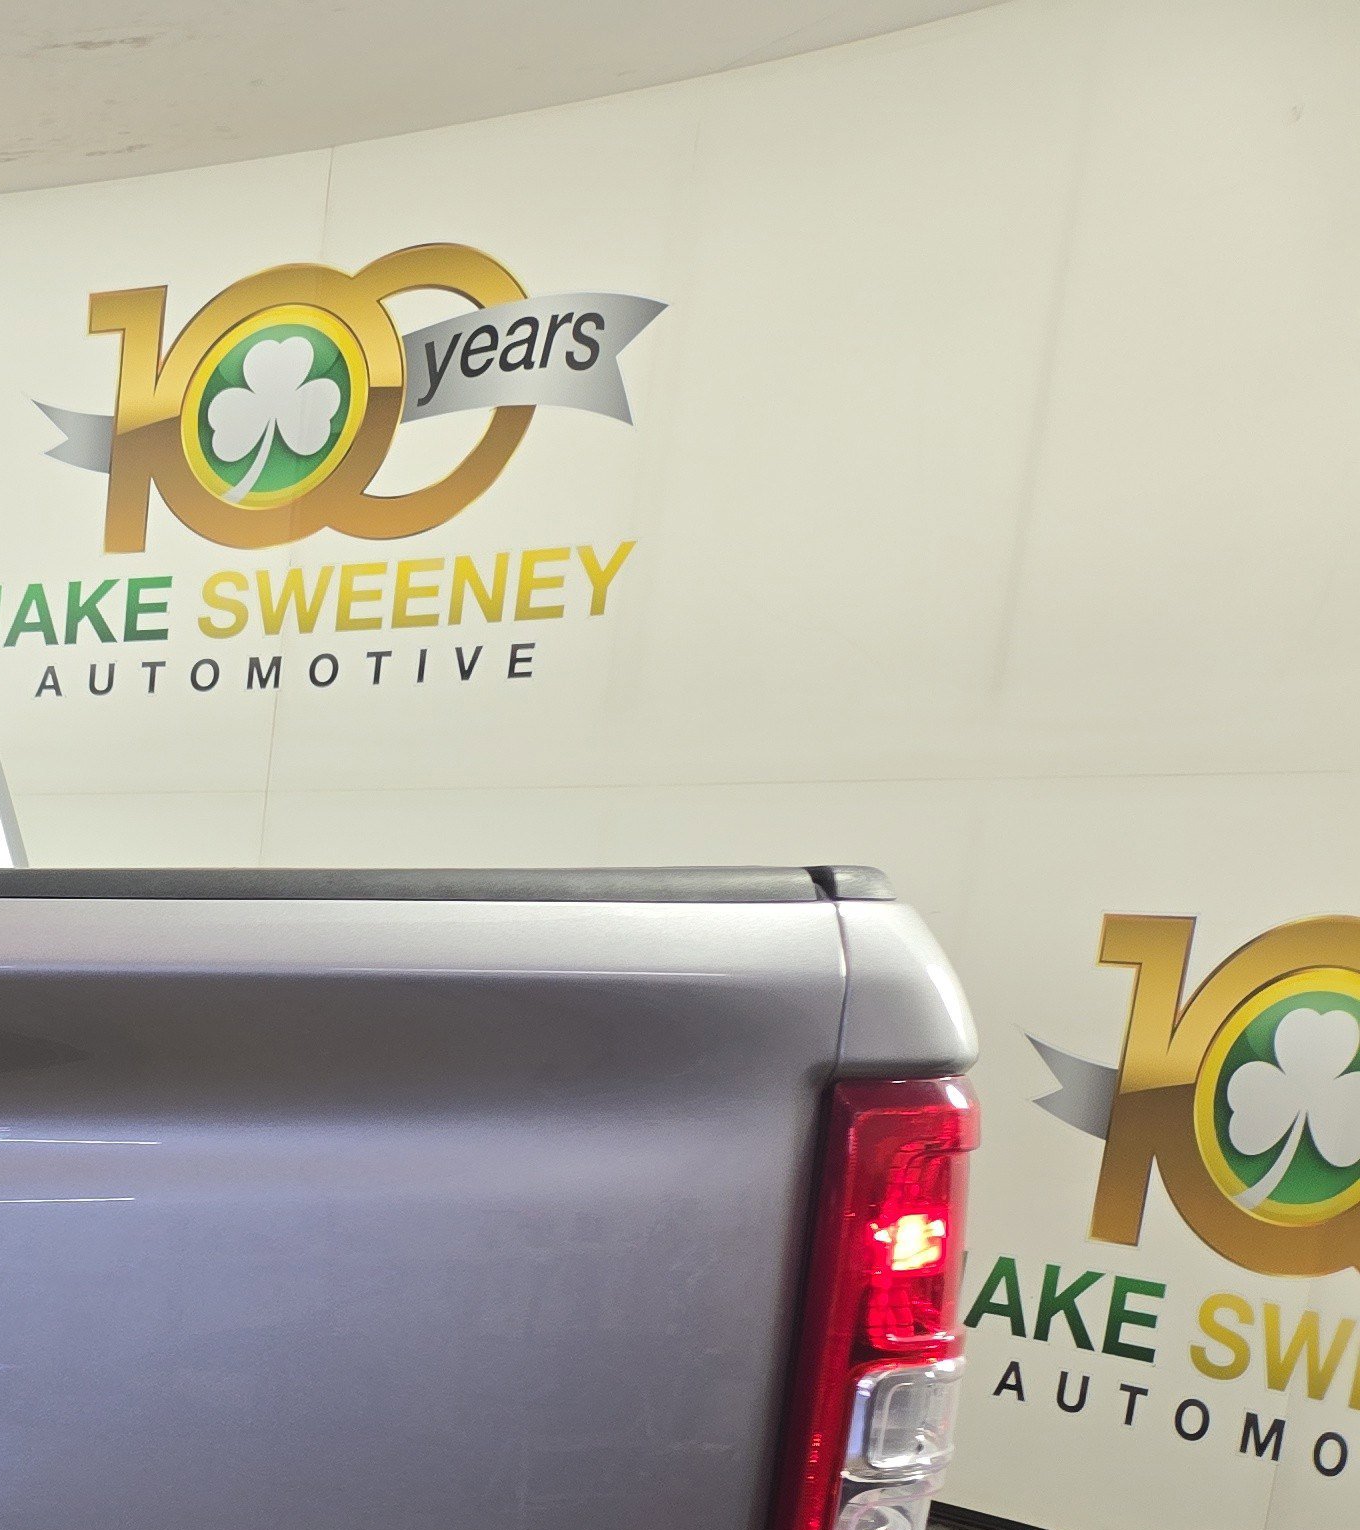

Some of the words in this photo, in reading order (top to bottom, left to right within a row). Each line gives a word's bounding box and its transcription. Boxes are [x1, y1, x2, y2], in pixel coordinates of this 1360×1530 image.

[88, 242, 536, 554] 100
[417, 310, 606, 407] years
[197, 540, 637, 640] SWEENEY
[35, 642, 537, 699] AUTOMOTIVE
[960, 1250, 1167, 1364] AKE
[1190, 1293, 1360, 1411] SW
[992, 1361, 1348, 1477] AUTOMO
